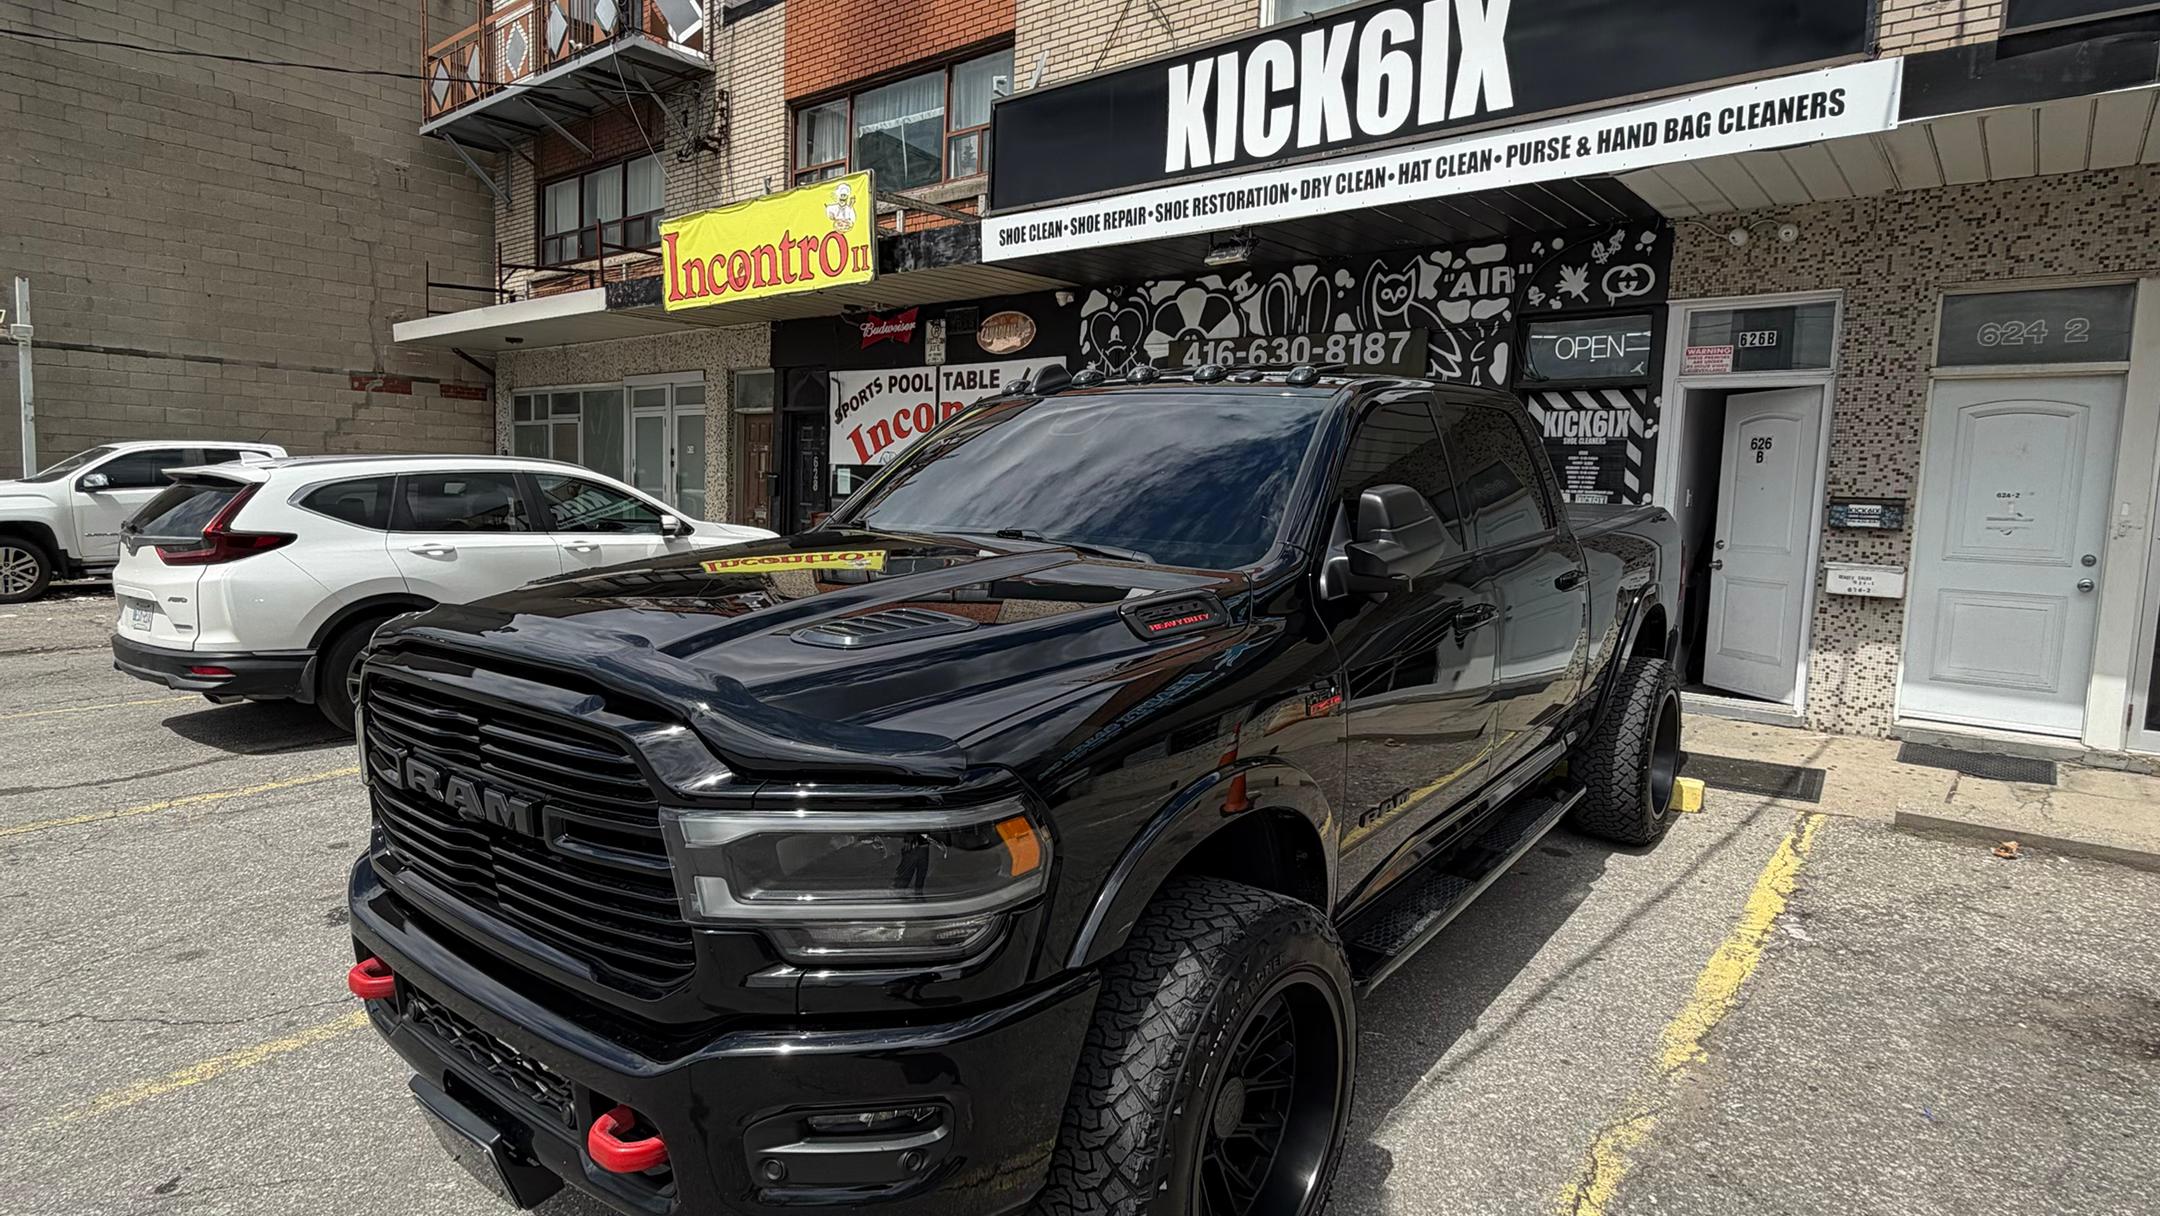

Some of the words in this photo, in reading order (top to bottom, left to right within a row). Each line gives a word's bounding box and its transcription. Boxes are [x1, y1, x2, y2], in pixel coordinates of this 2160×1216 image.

[1165, 0, 1514, 173] KICK6IX
[999, 226, 1027, 247] SHOE
[1028, 221, 1062, 242] CLEAN
[1070, 214, 1100, 236] SHOE
[1103, 207, 1147, 231] REPAIR
[1155, 200, 1189, 223] SHOE
[1192, 186, 1290, 217] RESTORATION
[1300, 179, 1332, 201] DRY
[1335, 168, 1387, 196] CLEAN
[1398, 159, 1432, 185] HAT
[1435, 147, 1493, 179] CLEAN
[1505, 135, 1571, 168] PURSE
[1575, 134, 1592, 157] &
[1597, 121, 1657, 155] HAND
[1663, 112, 1711, 144] BAG
[1718, 88, 1847, 136] CLEANERS
[851, 244, 870, 273] II
[860, 320, 916, 338] Budweiser
[1739, 331, 1776, 347] 626B
[1977, 320, 2048, 347] 624
[2064, 318, 2089, 343] 2
[1183, 331, 1411, 367] 416-630-8187
[1555, 335, 1625, 360] OPEN
[1687, 347, 1731, 355] WARNING
[834, 377, 883, 425] SPORTS
[888, 373, 933, 394] POOL
[943, 369, 1001, 391] TABLE
[1544, 410, 1630, 438] KICK6IX
[1750, 437, 1773, 450] 626
[1756, 451, 1764, 464] B
[406, 757, 534, 838] RAM
[1359, 788, 1410, 828] RAM
